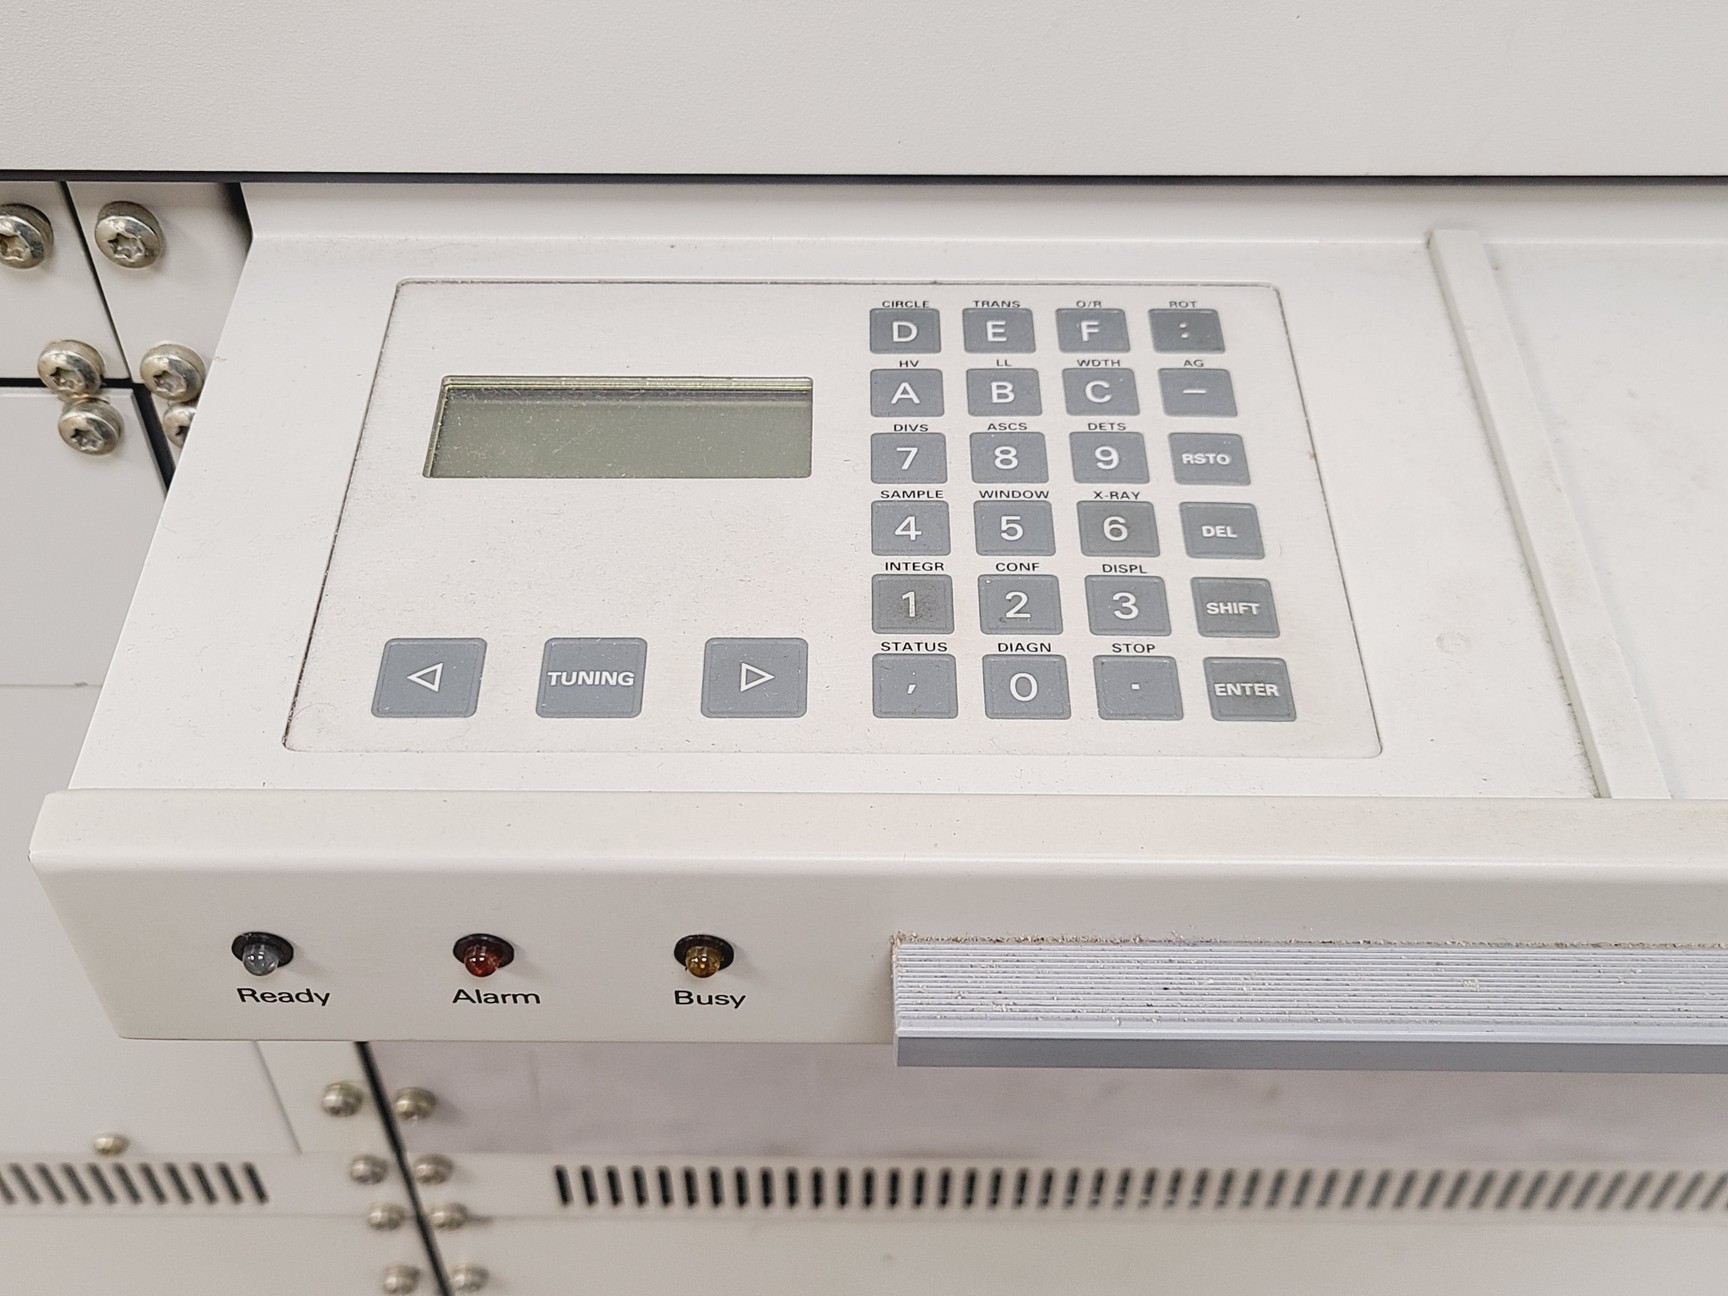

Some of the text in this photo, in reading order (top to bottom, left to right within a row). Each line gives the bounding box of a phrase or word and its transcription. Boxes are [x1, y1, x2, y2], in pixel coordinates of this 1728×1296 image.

[882, 300, 930, 308] CIRCLE
[973, 300, 1021, 308] TRANS
[1076, 300, 1102, 308] O/R
[892, 322, 917, 342] D
[987, 321, 1006, 341] E
[1081, 322, 1099, 341] F
[996, 359, 1011, 367] LL
[1077, 359, 1120, 367] WDTH
[891, 383, 920, 404] A
[991, 382, 1014, 403] B
[1085, 381, 1111, 402] C
[894, 424, 928, 432] DIVS
[987, 422, 1027, 431] ASCS
[1088, 422, 1126, 431] DETS
[897, 448, 918, 470] 7
[994, 447, 1018, 469] 8
[1095, 447, 1119, 469] 9
[1182, 454, 1231, 465] RSTO
[880, 491, 944, 499] SAMPLE
[979, 490, 1049, 498] WINDOW
[1094, 491, 1140, 500] X-RAY
[895, 516, 922, 540] 4
[1001, 516, 1023, 541] 5
[1104, 517, 1128, 541] 6
[1202, 526, 1237, 538] DEL
[885, 562, 944, 571] INTEGR
[996, 562, 1040, 572] CONF
[1102, 564, 1147, 573] DISPL
[902, 592, 916, 617] 1
[1006, 592, 1031, 618] 2
[1113, 592, 1138, 619] 3
[1206, 602, 1259, 615] SHIFT
[881, 642, 947, 652] STATUS
[997, 642, 1051, 652] DIAGN
[1112, 644, 1155, 653] STOP
[548, 671, 634, 686] TUNING
[1010, 673, 1037, 701] 0
[1215, 684, 1279, 697] ENTER
[237, 988, 330, 1007] Ready
[452, 989, 540, 1005] Alarm
[674, 990, 746, 1009] Busy
